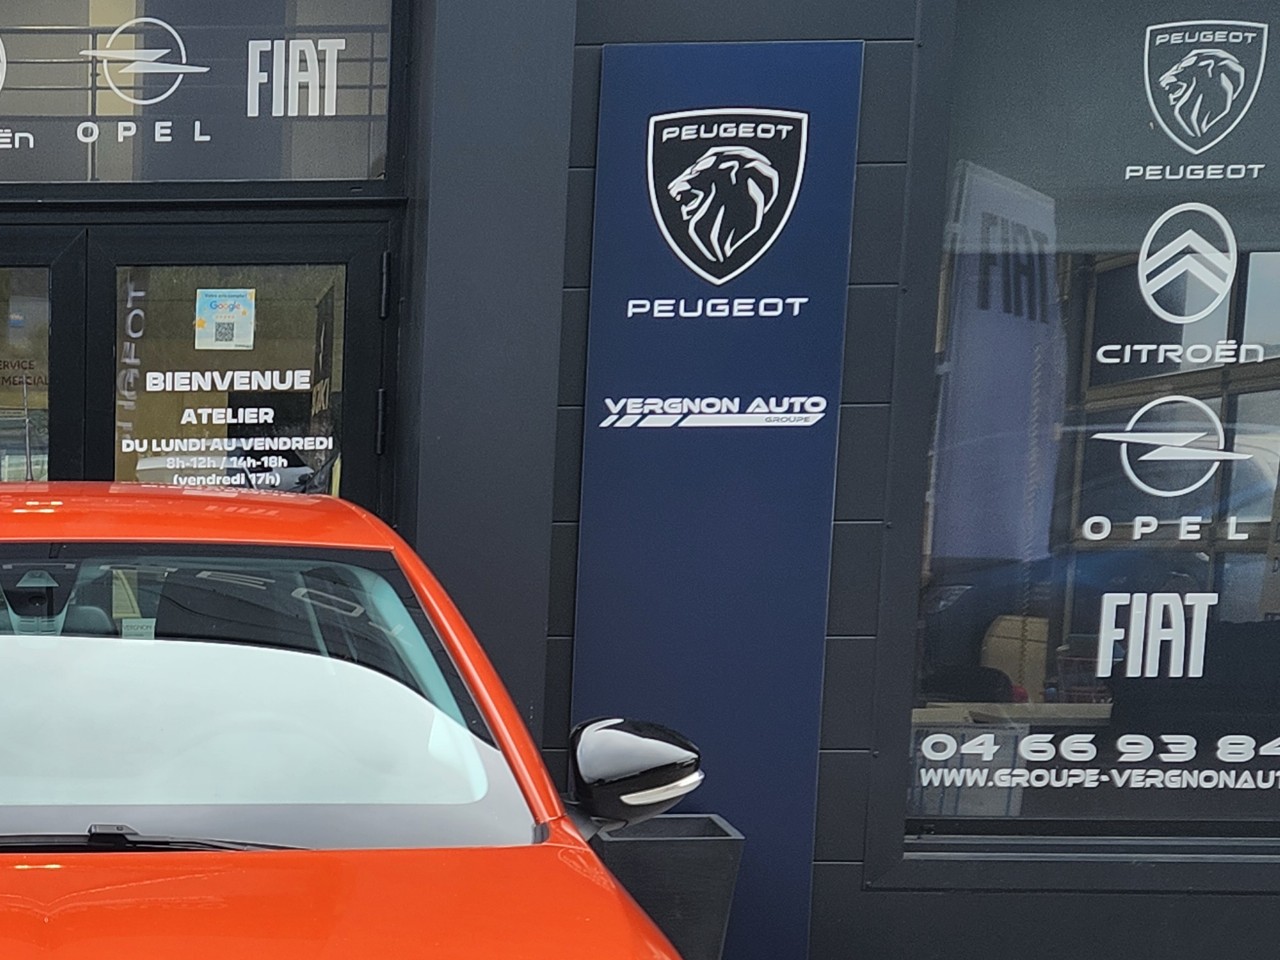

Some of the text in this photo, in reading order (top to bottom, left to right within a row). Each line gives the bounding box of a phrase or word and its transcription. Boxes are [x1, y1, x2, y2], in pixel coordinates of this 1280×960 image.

[1155, 31, 1257, 46] PEUGEOT
[247, 38, 346, 117] FIAT
[76, 120, 212, 143] OPEL
[661, 123, 794, 143] PEUGEOT
[1125, 164, 1266, 180] PEUGEOT
[209, 300, 241, 312] Google
[627, 297, 809, 318] PEUGEOT
[146, 369, 311, 392] BIENVENUE
[604, 397, 827, 414] VERGNON AUTO
[180, 407, 275, 425] ATELIER
[764, 416, 811, 424] GROUPE
[121, 436, 333, 453] DU LUNDI AU VENDREDI
[166, 456, 217, 470] 8h-12h
[230, 456, 288, 469] 14h-18h
[173, 472, 281, 487] (vendredi 17h)
[1082, 515, 1249, 541] OPEL
[1096, 592, 1219, 678] FIAT
[921, 733, 1001, 761] 04
[1018, 733, 1097, 762] 66
[1116, 734, 1197, 762] 93
[919, 768, 1280, 789] WWW.GROUPE-VERGNONAU
